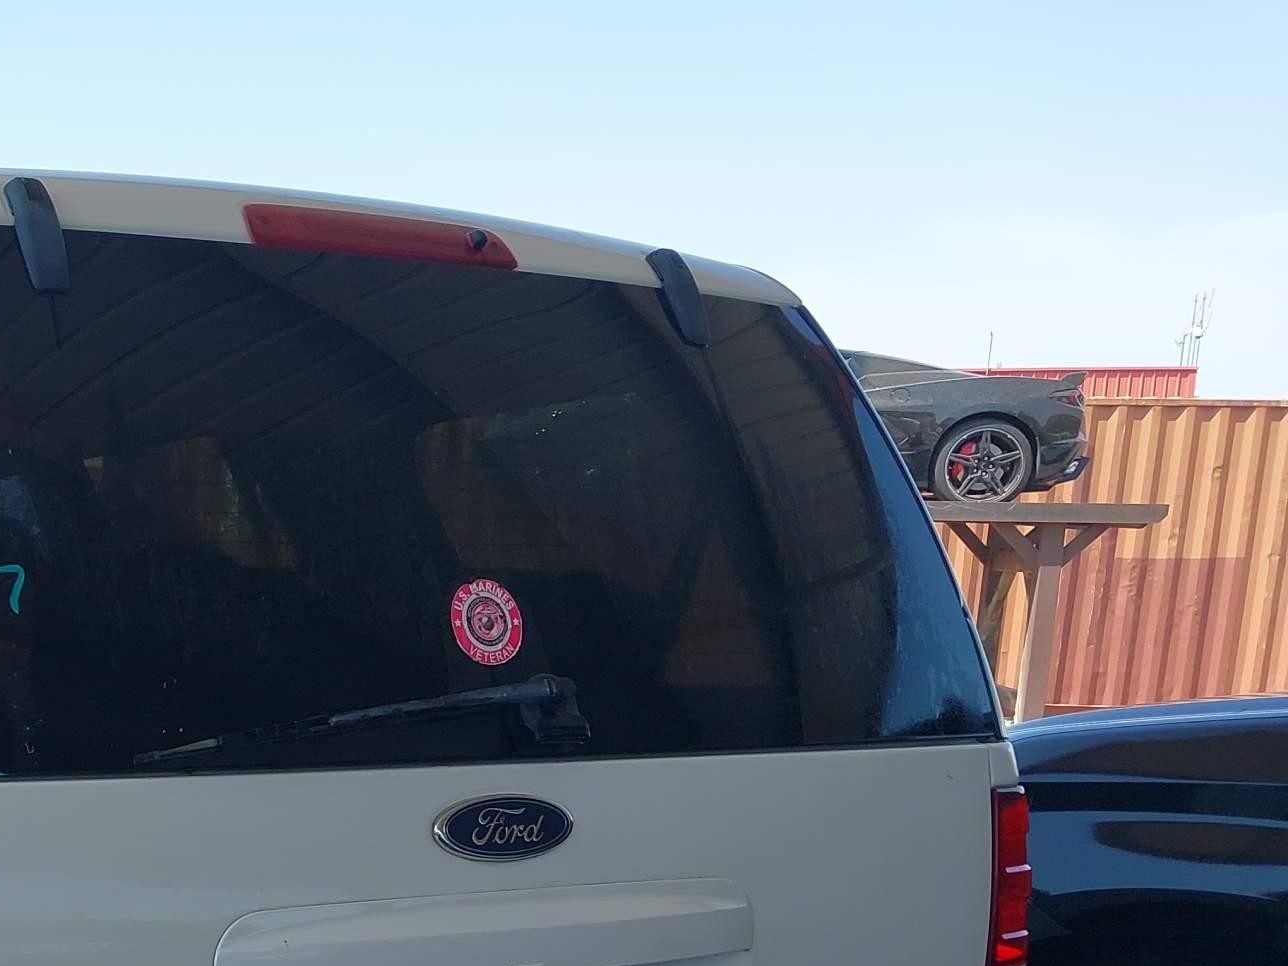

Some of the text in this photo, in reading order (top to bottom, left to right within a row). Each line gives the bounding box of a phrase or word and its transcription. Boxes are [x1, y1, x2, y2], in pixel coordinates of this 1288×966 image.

[453, 581, 514, 611] U.S. MARINES
[469, 643, 515, 663] VETERAN
[471, 807, 545, 846] Ford
